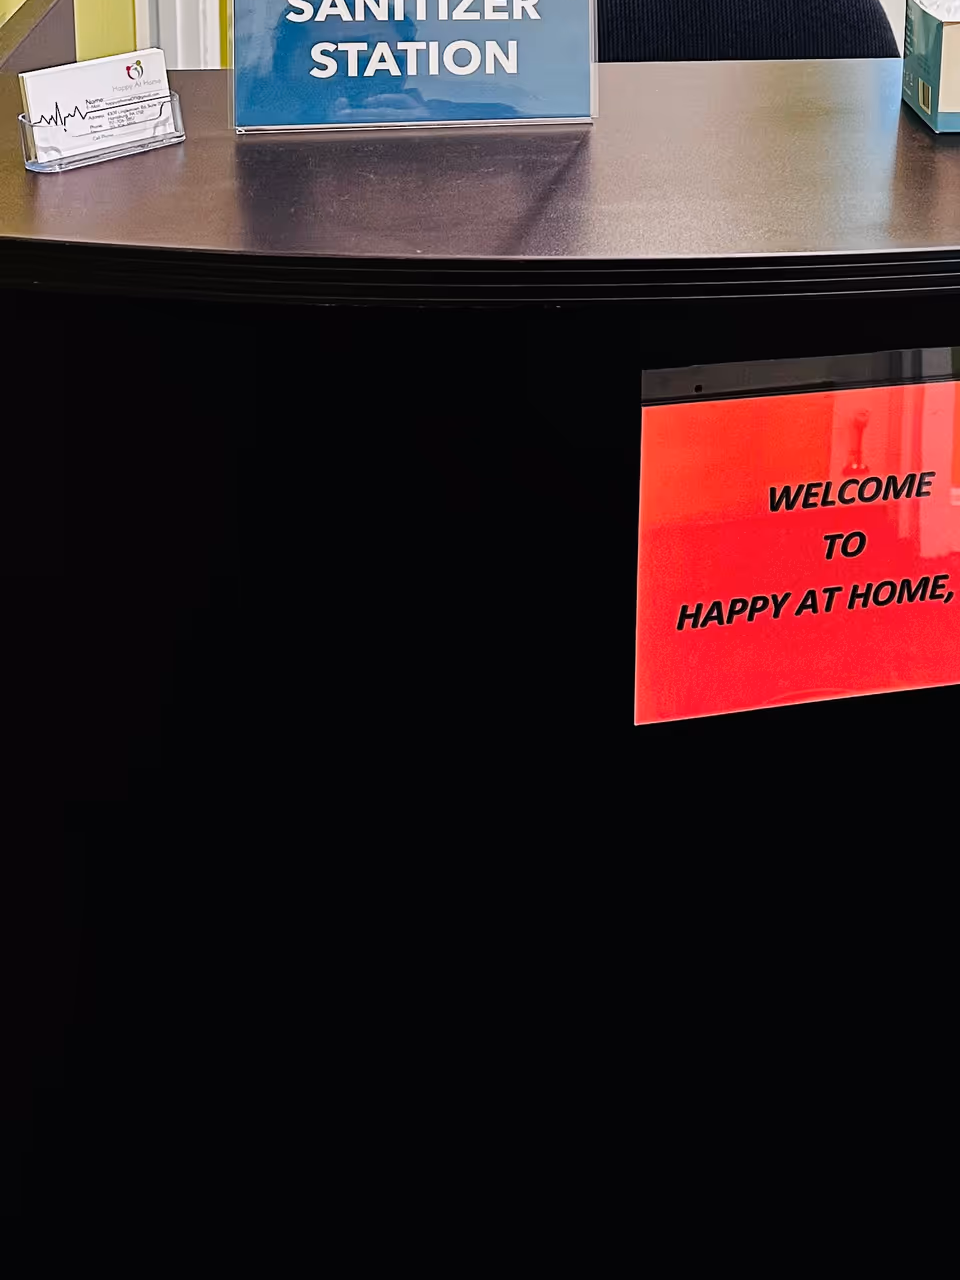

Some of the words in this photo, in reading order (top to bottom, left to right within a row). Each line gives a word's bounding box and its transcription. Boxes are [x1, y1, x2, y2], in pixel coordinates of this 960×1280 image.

[309, 40, 518, 79] STATION
[768, 471, 936, 512] WELCOME
[823, 531, 866, 560] TO
[676, 592, 792, 631] HAPPY
[794, 587, 843, 617] AT
[847, 574, 955, 610] HOME,
